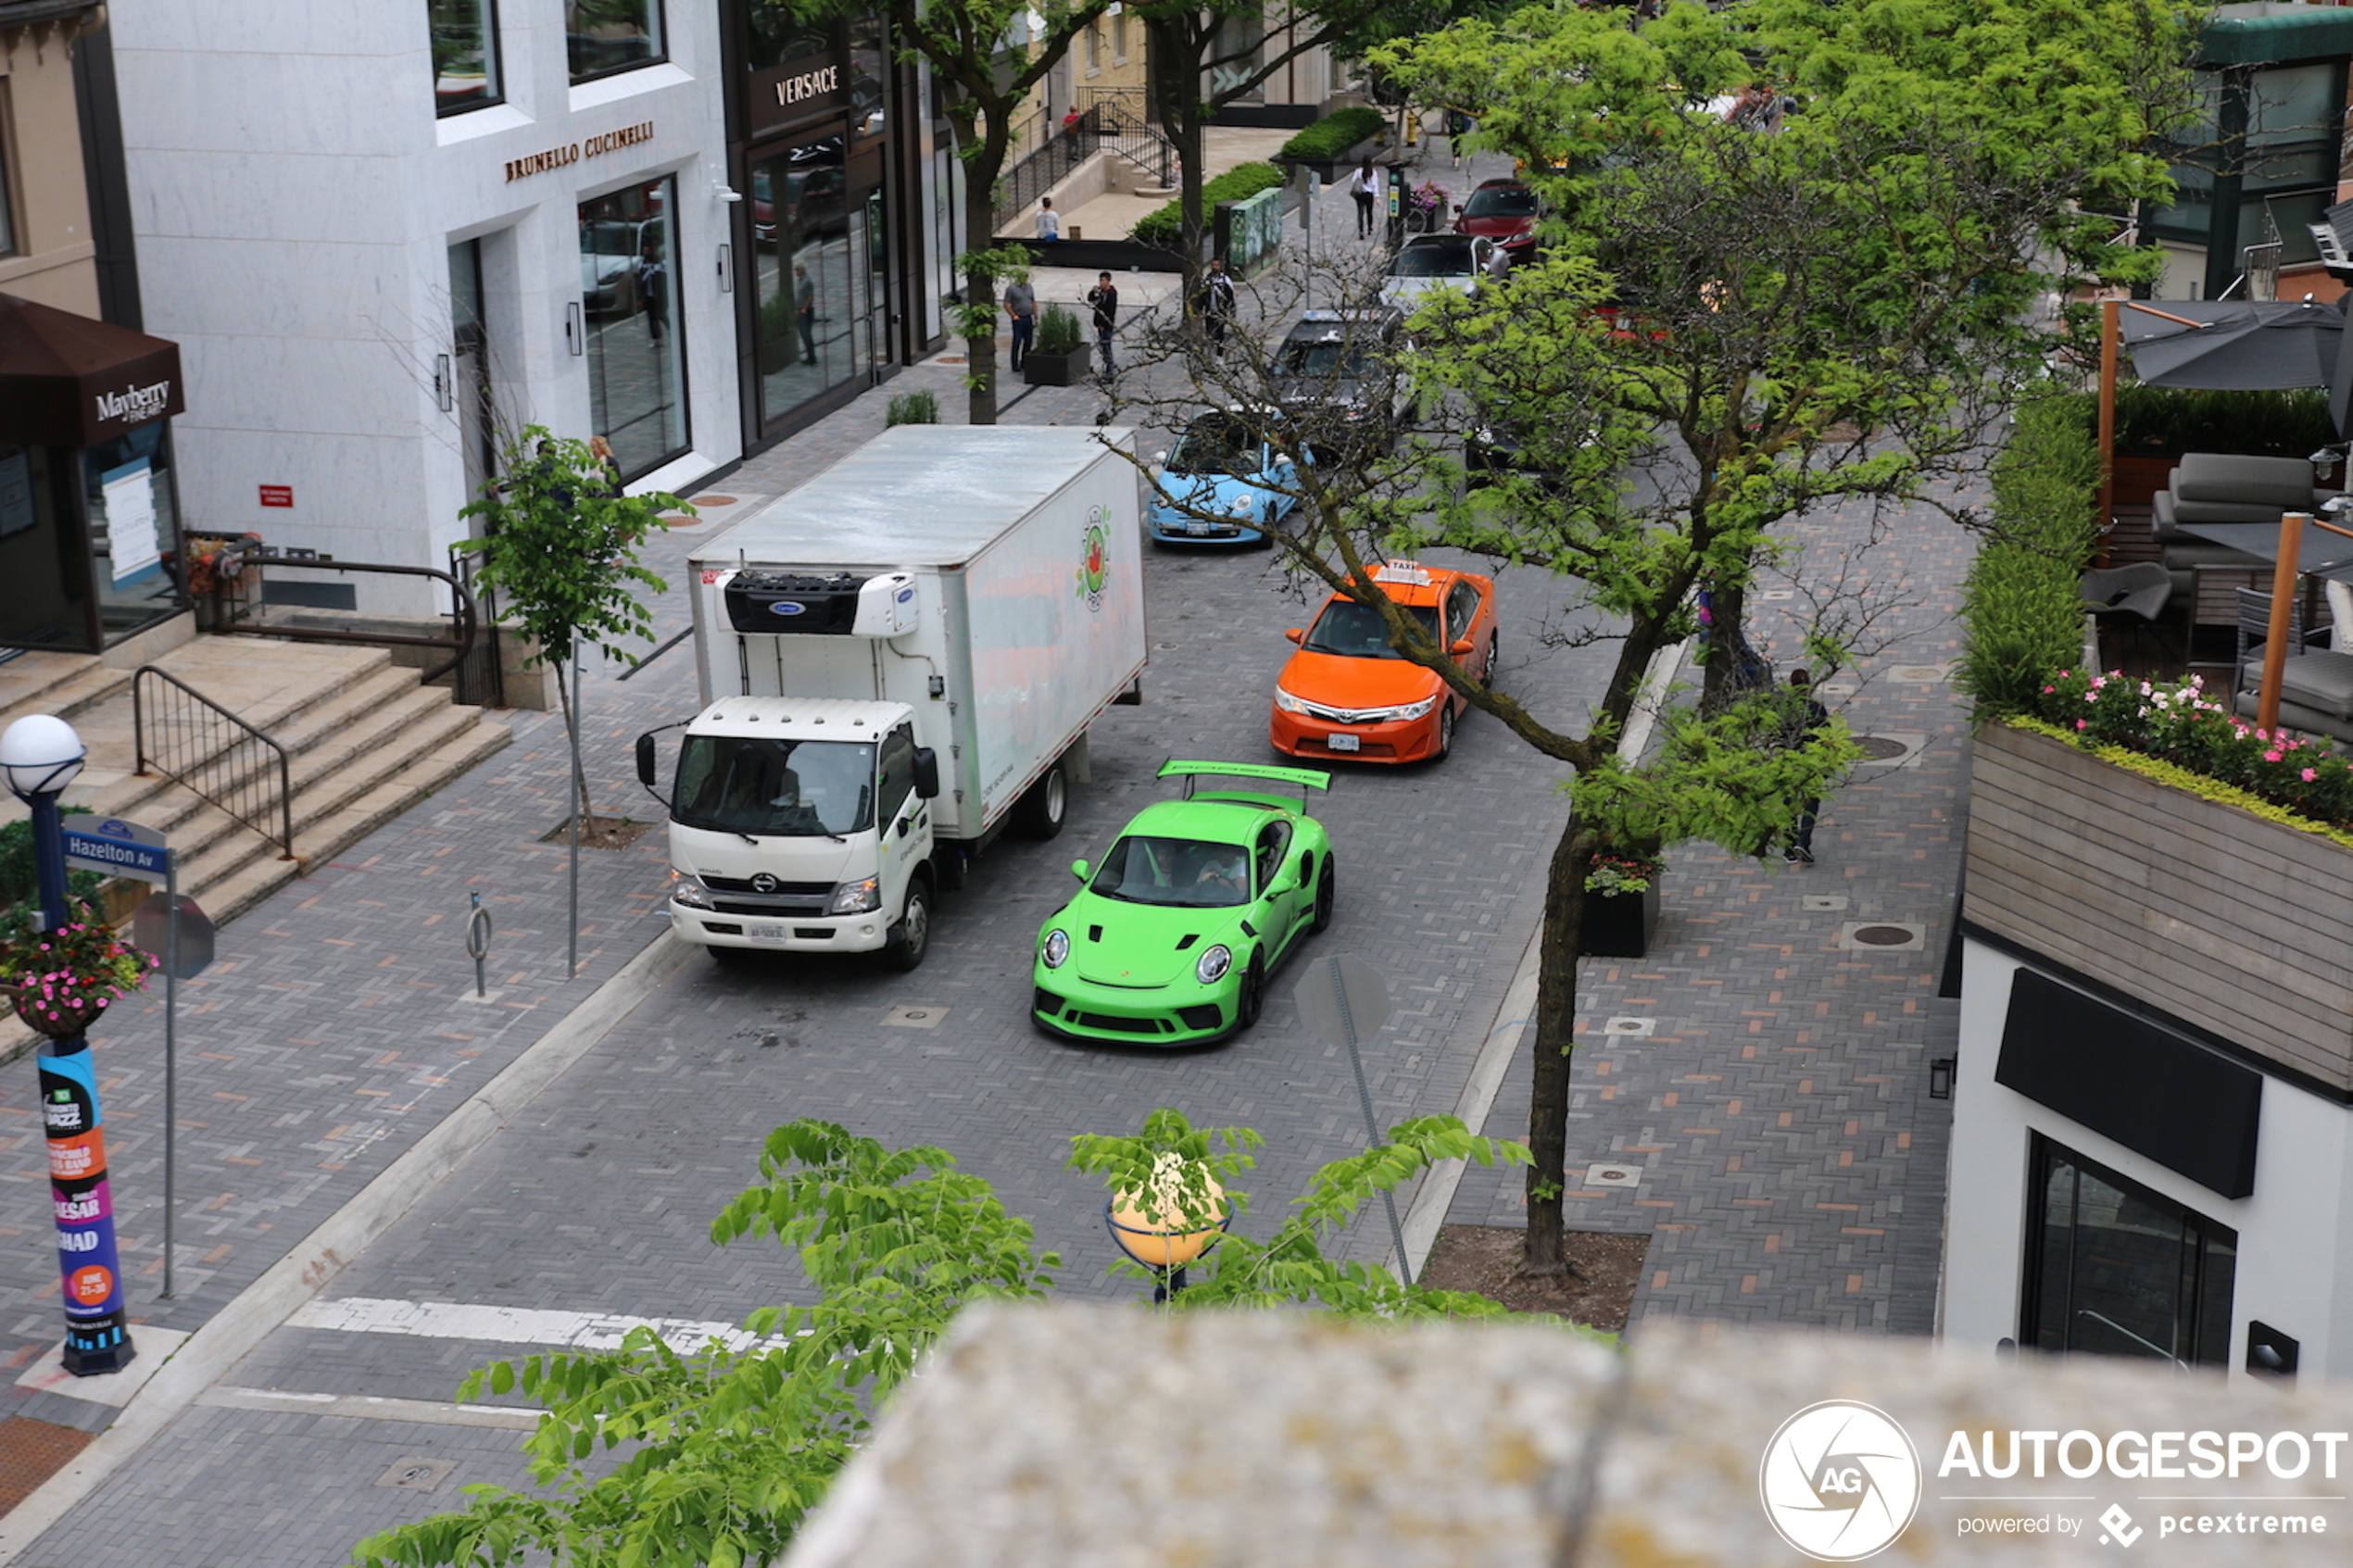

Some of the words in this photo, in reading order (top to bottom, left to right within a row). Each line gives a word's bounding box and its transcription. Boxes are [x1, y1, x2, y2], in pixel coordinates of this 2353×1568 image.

[776, 65, 838, 106] VERSACE
[503, 143, 580, 182] BRUNELLO
[584, 120, 653, 158] CUCINELLI
[95, 380, 170, 421] Mayberry
[1393, 561, 1415, 571] TAXI
[69, 836, 134, 863] Hazelton
[137, 852, 153, 866] Av
[82, 1272, 104, 1285] JUNE
